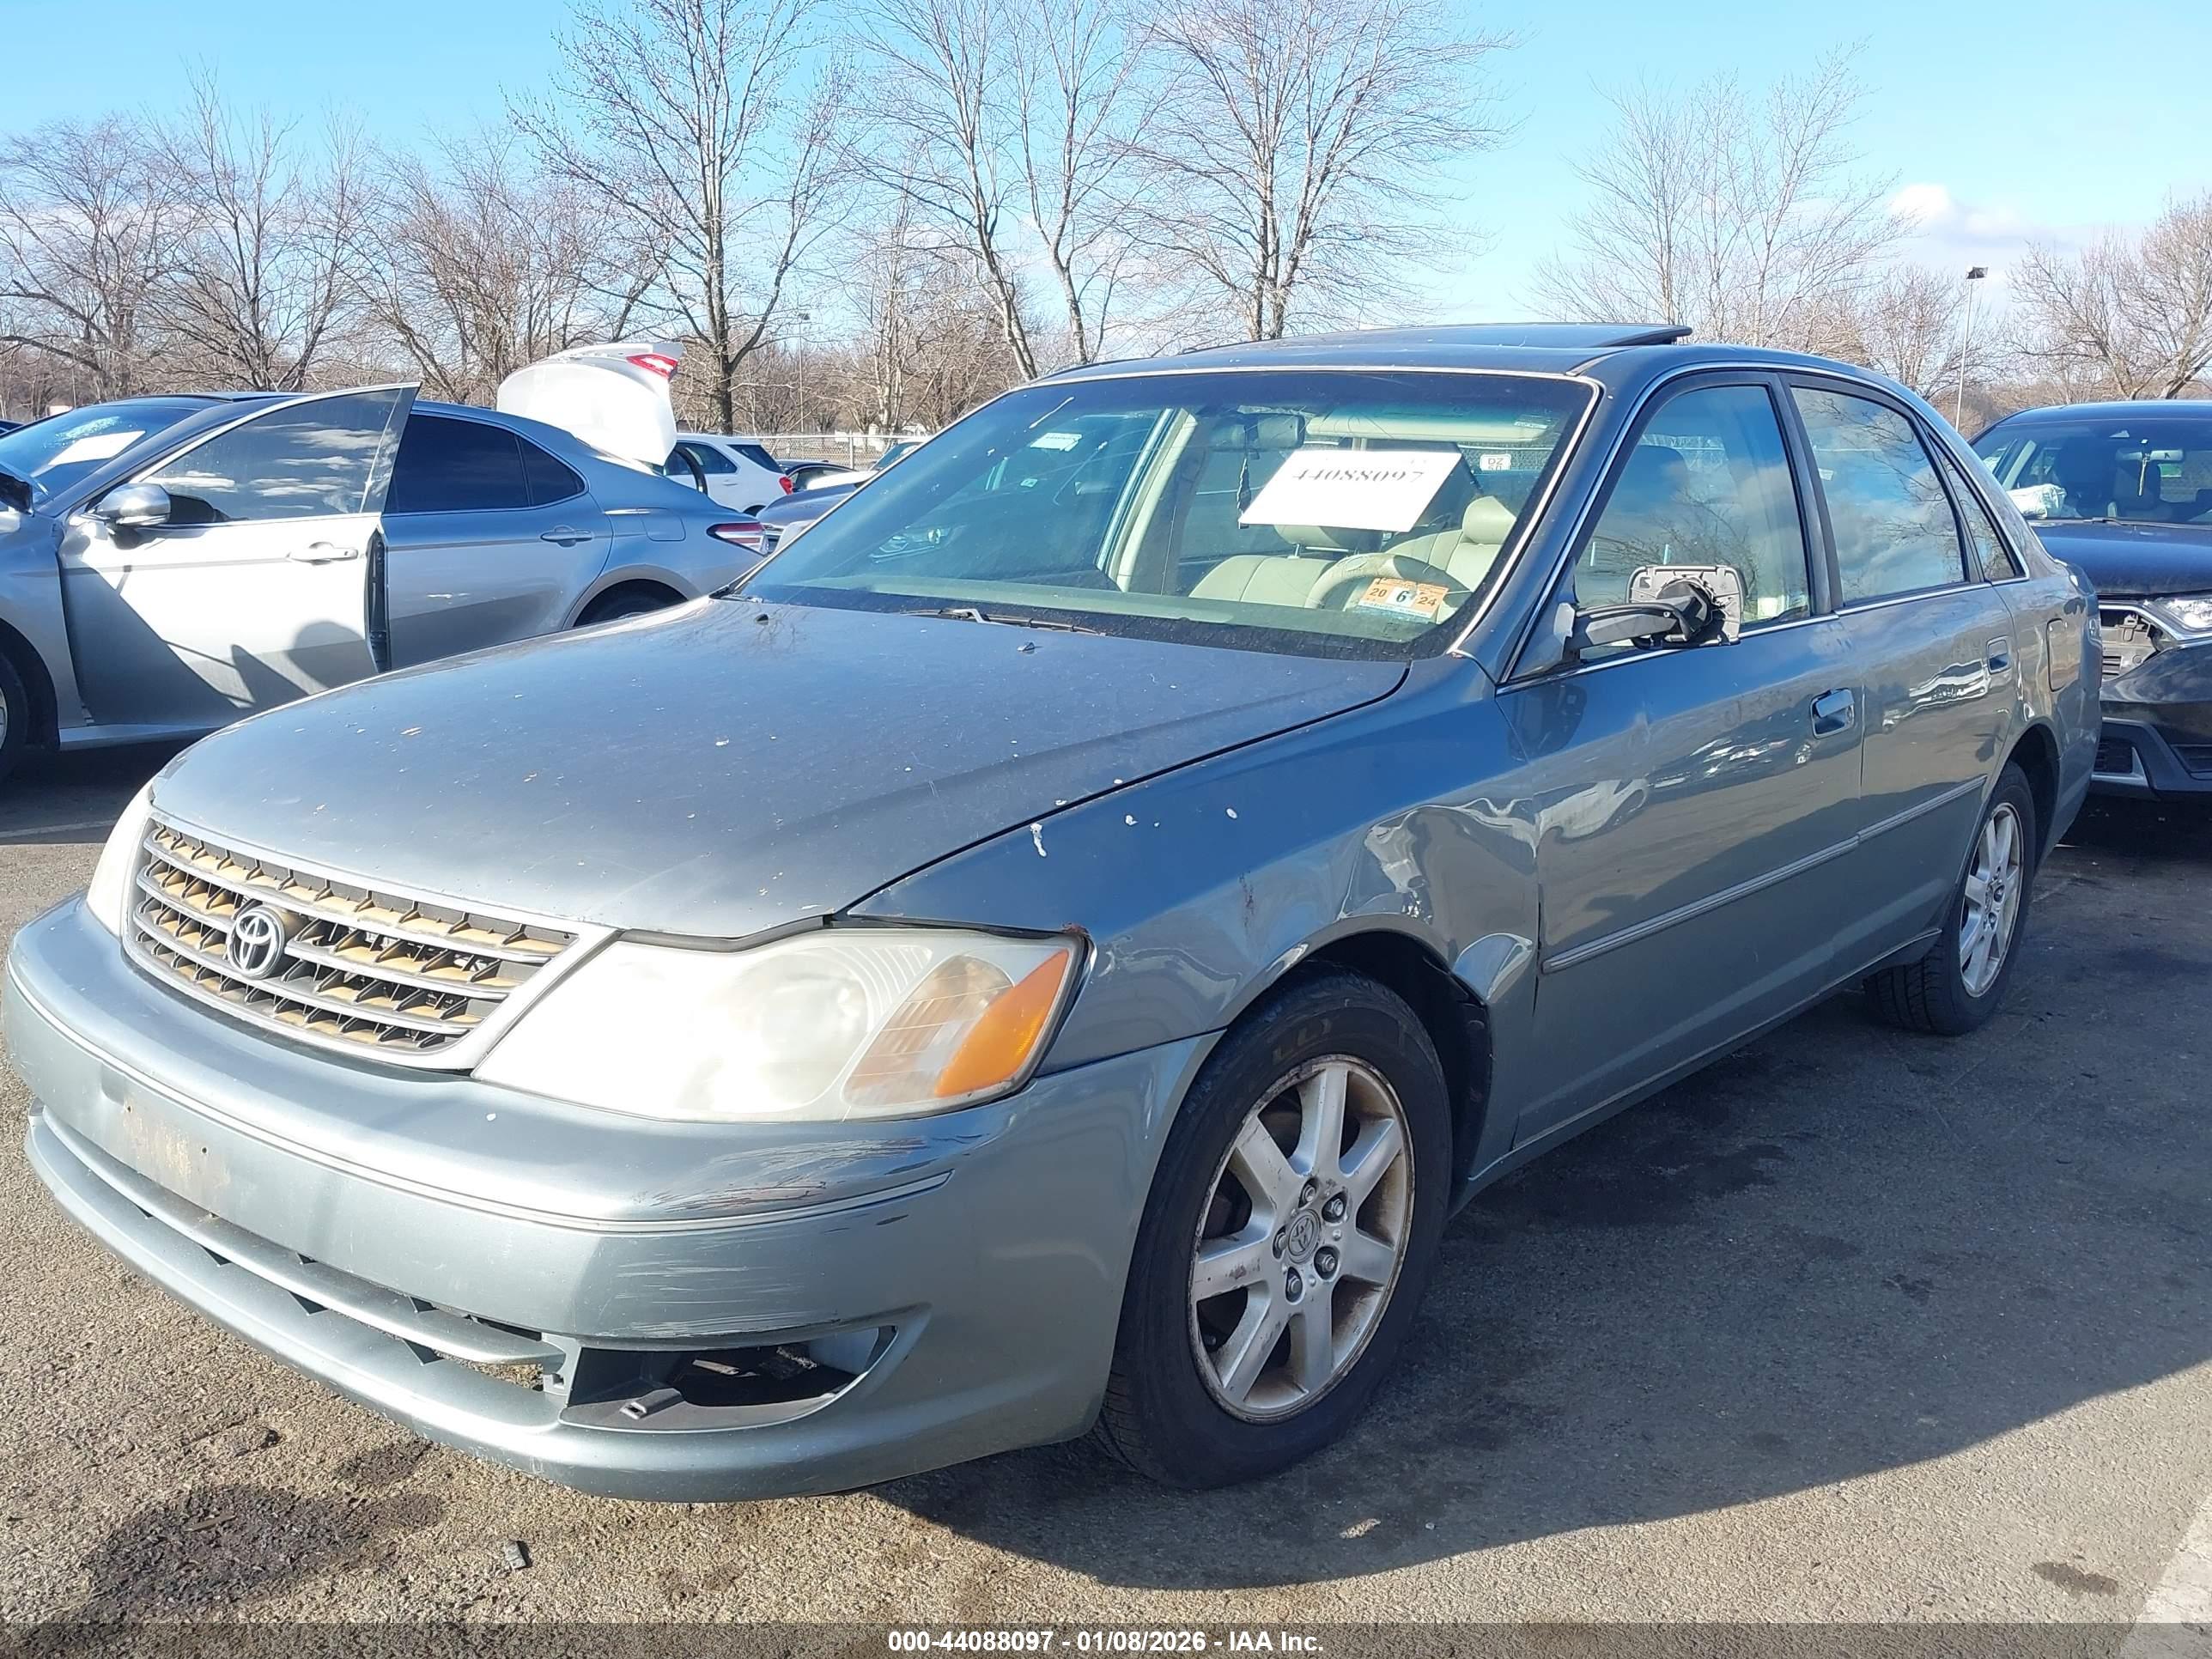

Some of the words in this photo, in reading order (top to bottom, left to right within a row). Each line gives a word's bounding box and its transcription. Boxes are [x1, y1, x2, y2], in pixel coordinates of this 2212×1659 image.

[1369, 587, 1388, 598] 20
[1395, 590, 1410, 603] 6
[1417, 596, 1438, 607] 24
